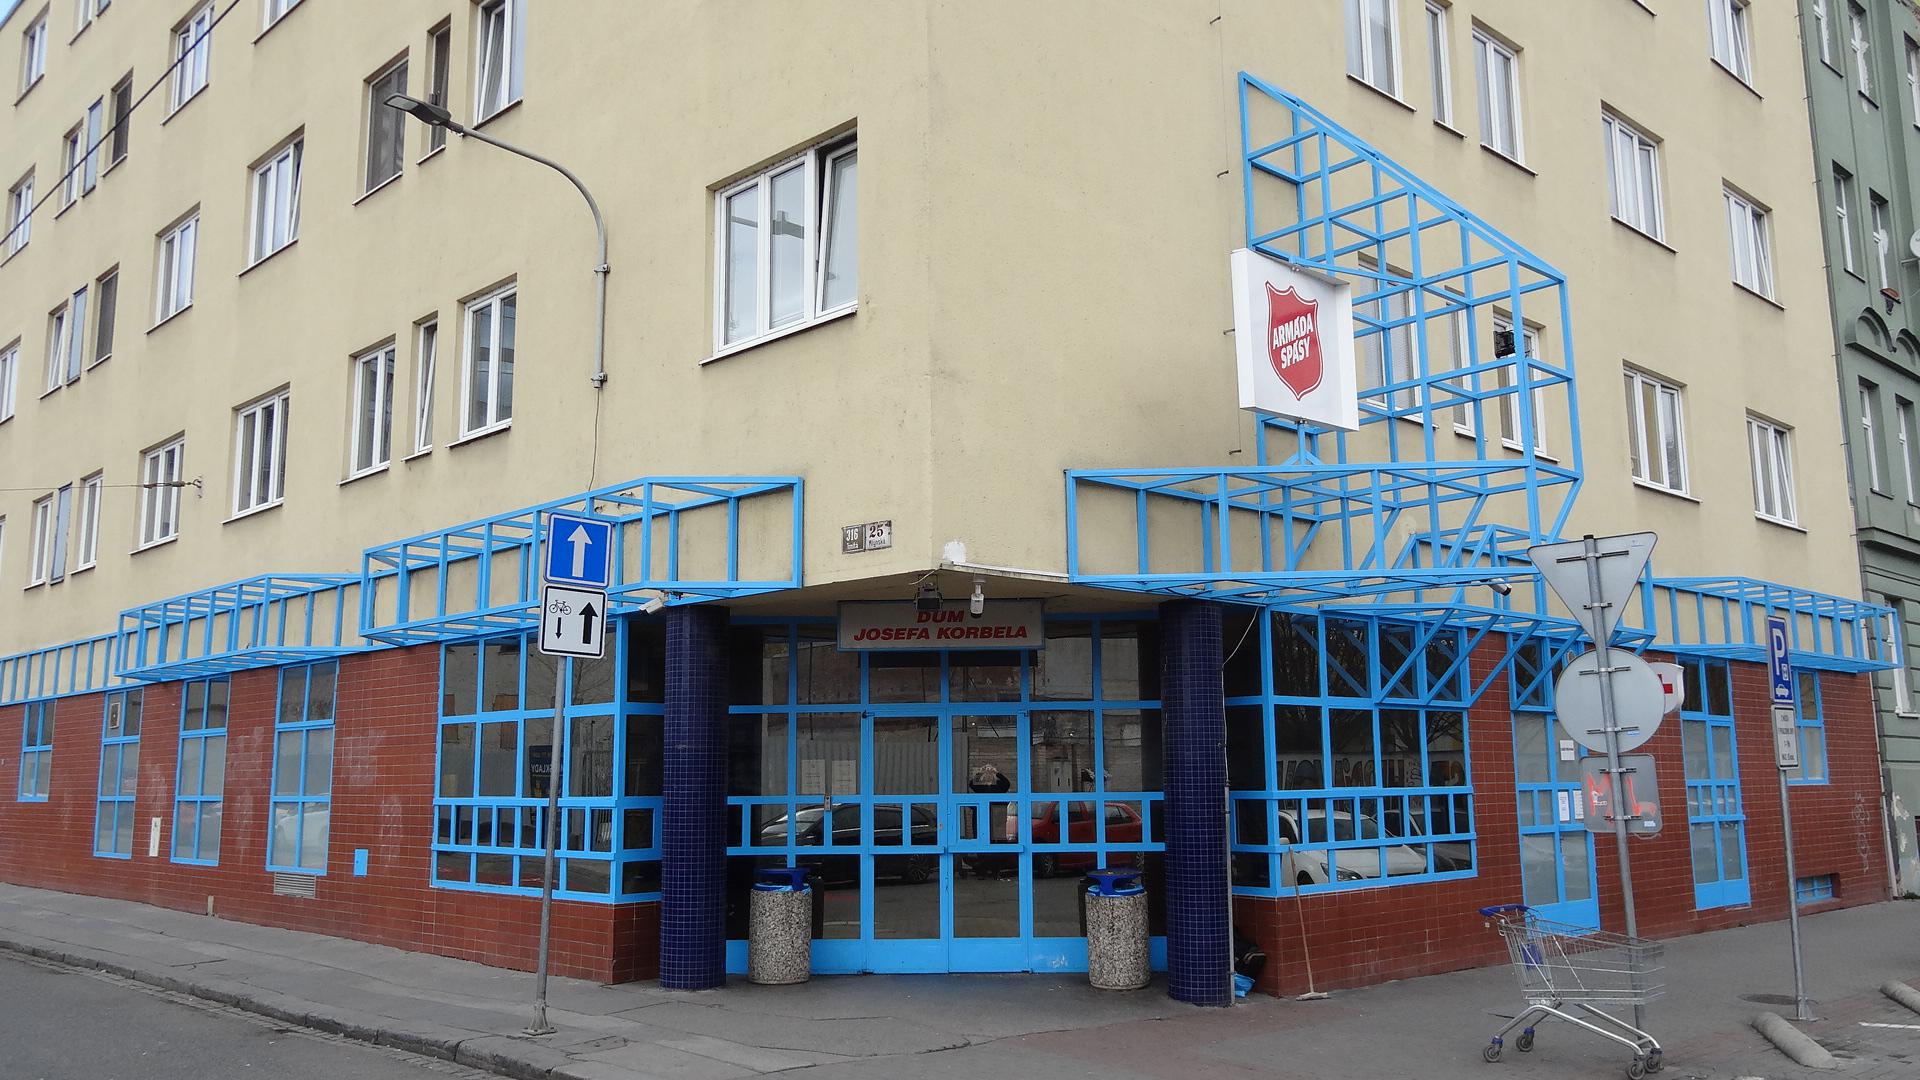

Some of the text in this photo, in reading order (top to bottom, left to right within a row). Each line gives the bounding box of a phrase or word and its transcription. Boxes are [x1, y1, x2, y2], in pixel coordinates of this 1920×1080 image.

[1272, 312, 1314, 350] ARMÁDA
[1280, 336, 1311, 369] SPÁSY
[846, 529, 859, 542] 316
[869, 524, 883, 538] 25
[853, 626, 1028, 641] JOSEFA KORBELA
[1772, 628, 1786, 676] P
